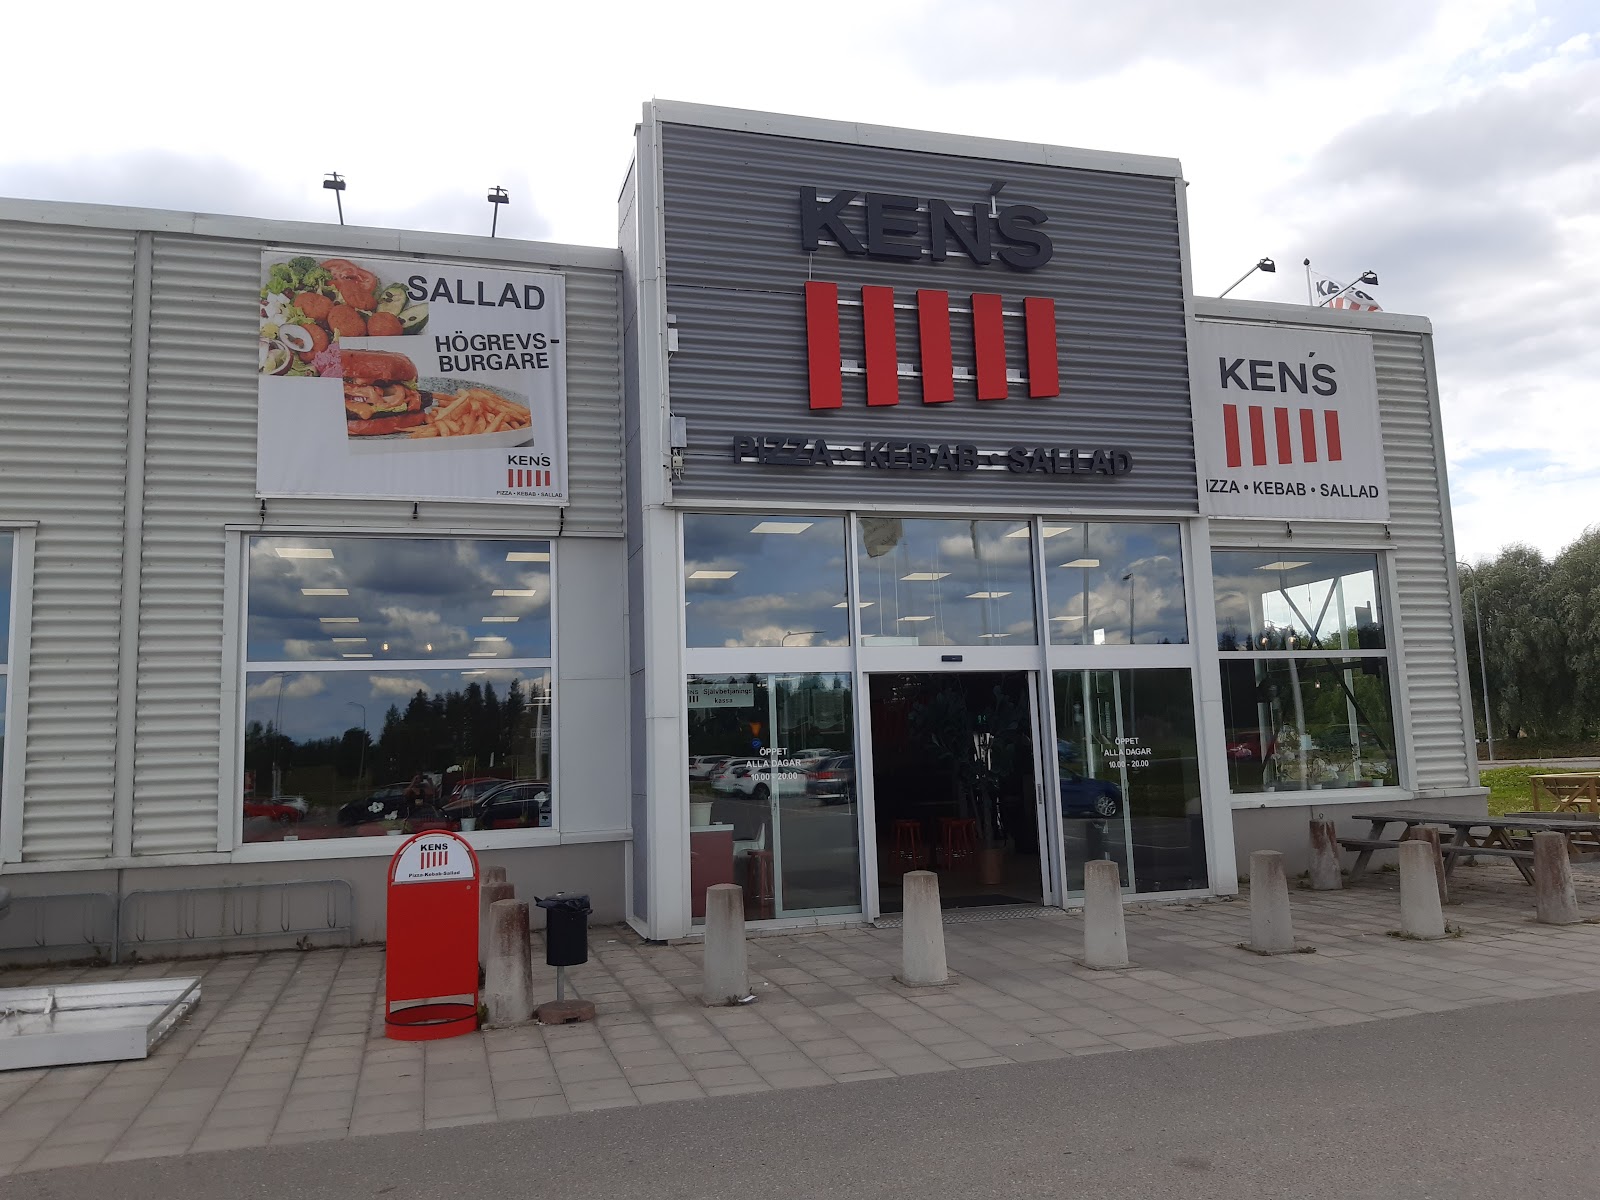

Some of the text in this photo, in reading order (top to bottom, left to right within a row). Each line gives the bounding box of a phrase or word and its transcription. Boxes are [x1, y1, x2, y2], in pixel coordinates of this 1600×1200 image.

[407, 275, 545, 311] SALLAD
[435, 331, 560, 352] HÖGREVS-
[438, 352, 550, 372] BURGARE
[733, 435, 1133, 476] PIZZA KEBAB SALLAD
[1205, 479, 1379, 498] IZZA KEBAB SALLAD
[1115, 737, 1139, 745] ÖPPET
[759, 747, 788, 756] ÖPPET
[1126, 748, 1152, 756] DAGAR
[746, 758, 801, 768] ALLA DAGAR
[751, 773, 770, 781] 10.00
[777, 772, 798, 780] 20.00
[420, 843, 448, 851] KENS
